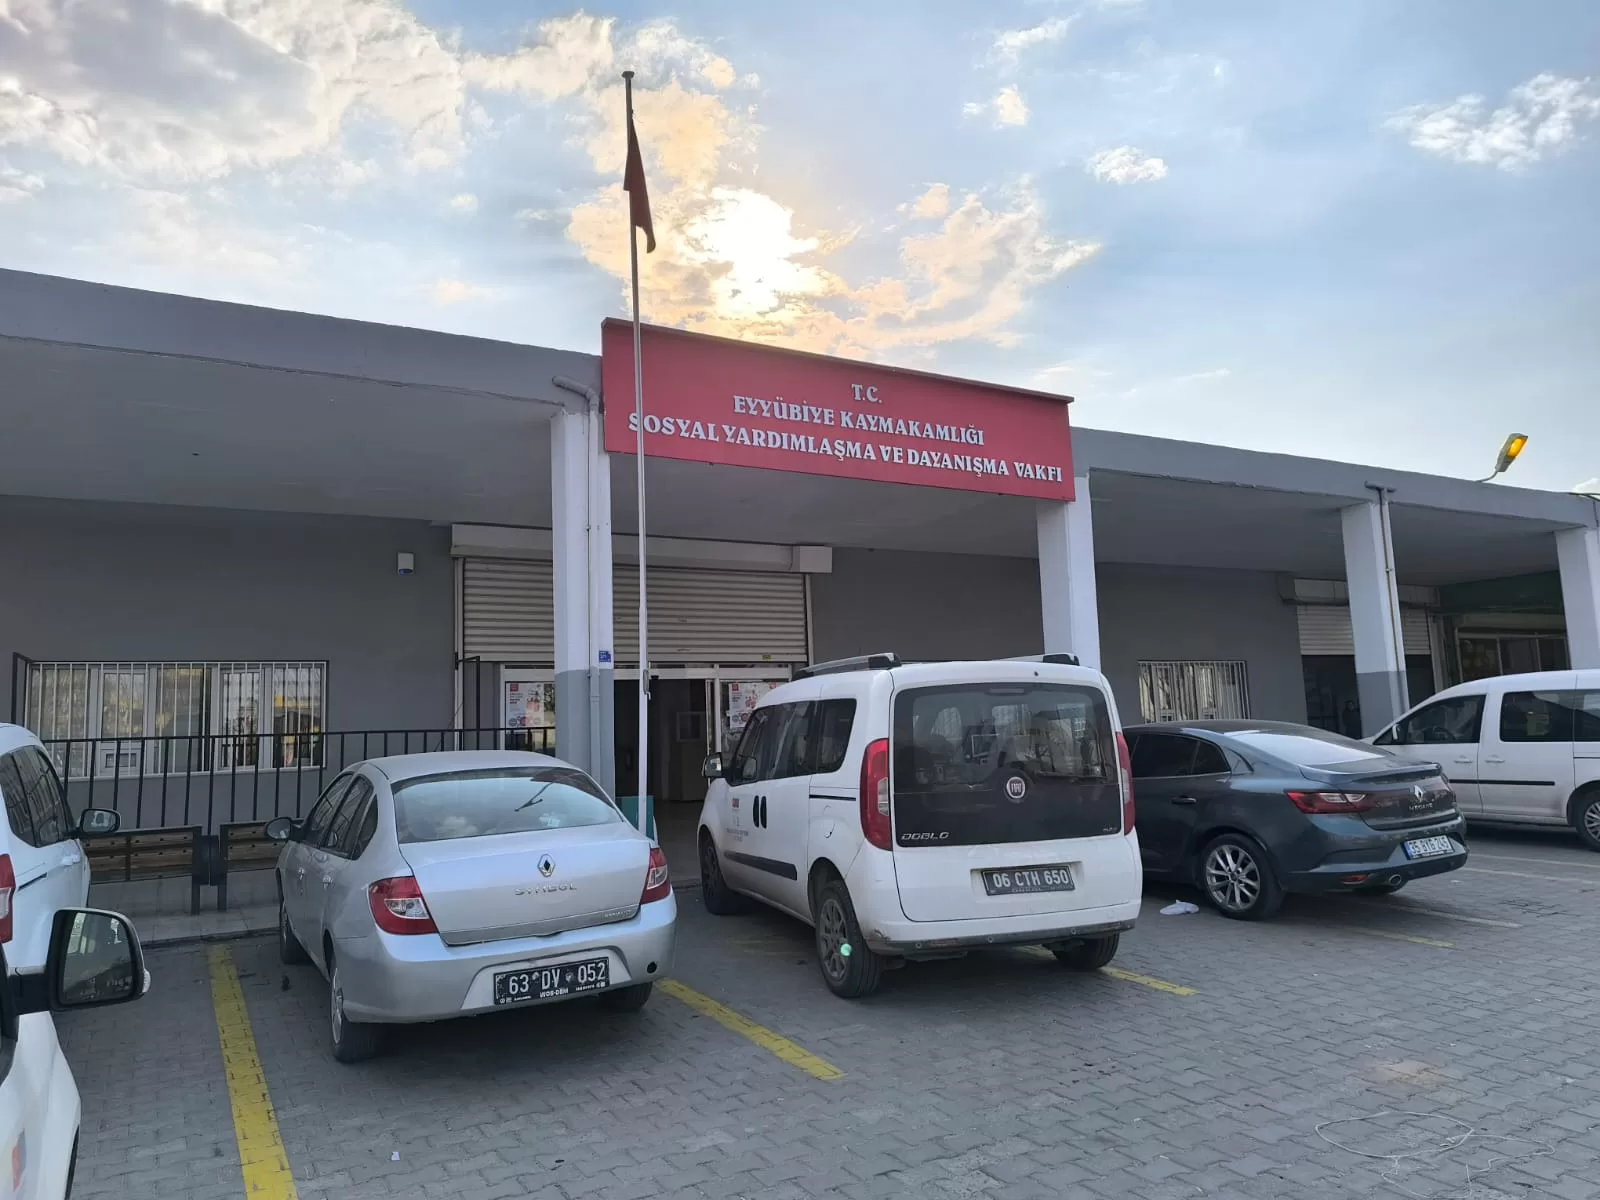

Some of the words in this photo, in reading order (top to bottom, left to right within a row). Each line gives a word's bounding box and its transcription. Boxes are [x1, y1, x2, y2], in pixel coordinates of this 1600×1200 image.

[851, 384, 882, 403] T.C.
[733, 395, 834, 426] EYYÜBİYE
[840, 411, 985, 446] KAYMAKAMLIĞI
[628, 412, 720, 442] SOSYAL
[723, 425, 877, 462] YARDIMLAŞMA
[879, 445, 904, 464] VE
[907, 449, 1010, 478] DAYANIŞMA
[1014, 461, 1063, 483] VAKFI
[901, 831, 950, 840] DOBLO
[992, 873, 1012, 888] 06
[1014, 871, 1041, 887] CTH
[1043, 869, 1070, 886] 650
[509, 973, 530, 996] 63
[541, 968, 561, 991] DV
[577, 962, 606, 984] 052
